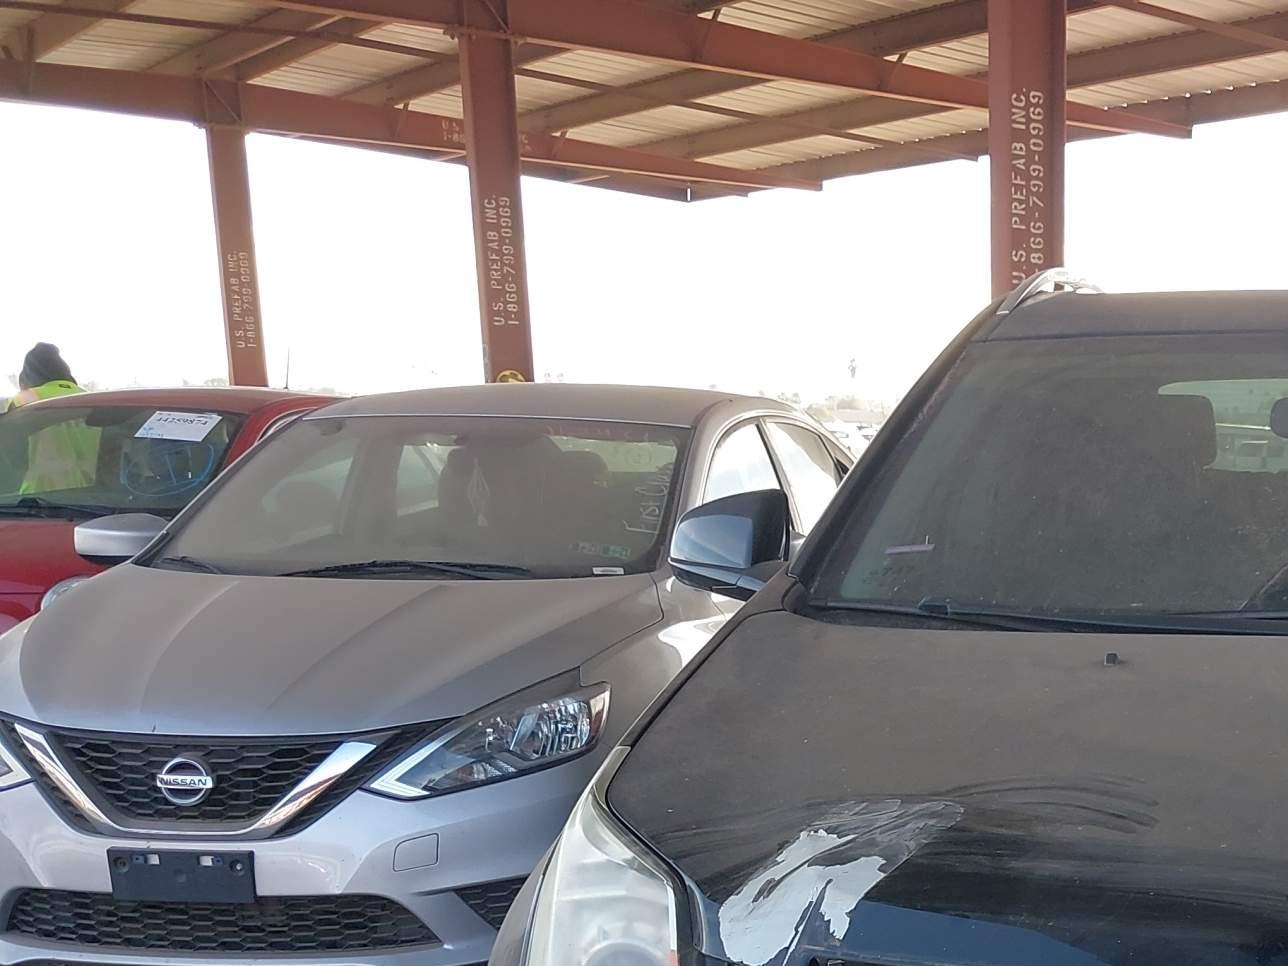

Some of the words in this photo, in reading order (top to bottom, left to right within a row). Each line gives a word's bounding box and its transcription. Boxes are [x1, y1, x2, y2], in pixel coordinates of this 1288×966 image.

[1011, 87, 1027, 130] INC.
[1011, 141, 1027, 230] PREFAB
[1029, 90, 1044, 273] -866-799-0969
[484, 194, 498, 223] INC.
[487, 231, 502, 289] PREFAB
[499, 196, 520, 325] 1-866-799-0969
[1011, 243, 1027, 286] U.S.
[230, 277, 243, 321] PREFAB
[492, 297, 505, 326] U.S.
[235, 327, 246, 348] U.S.
[159, 777, 208, 786] NISSAN
